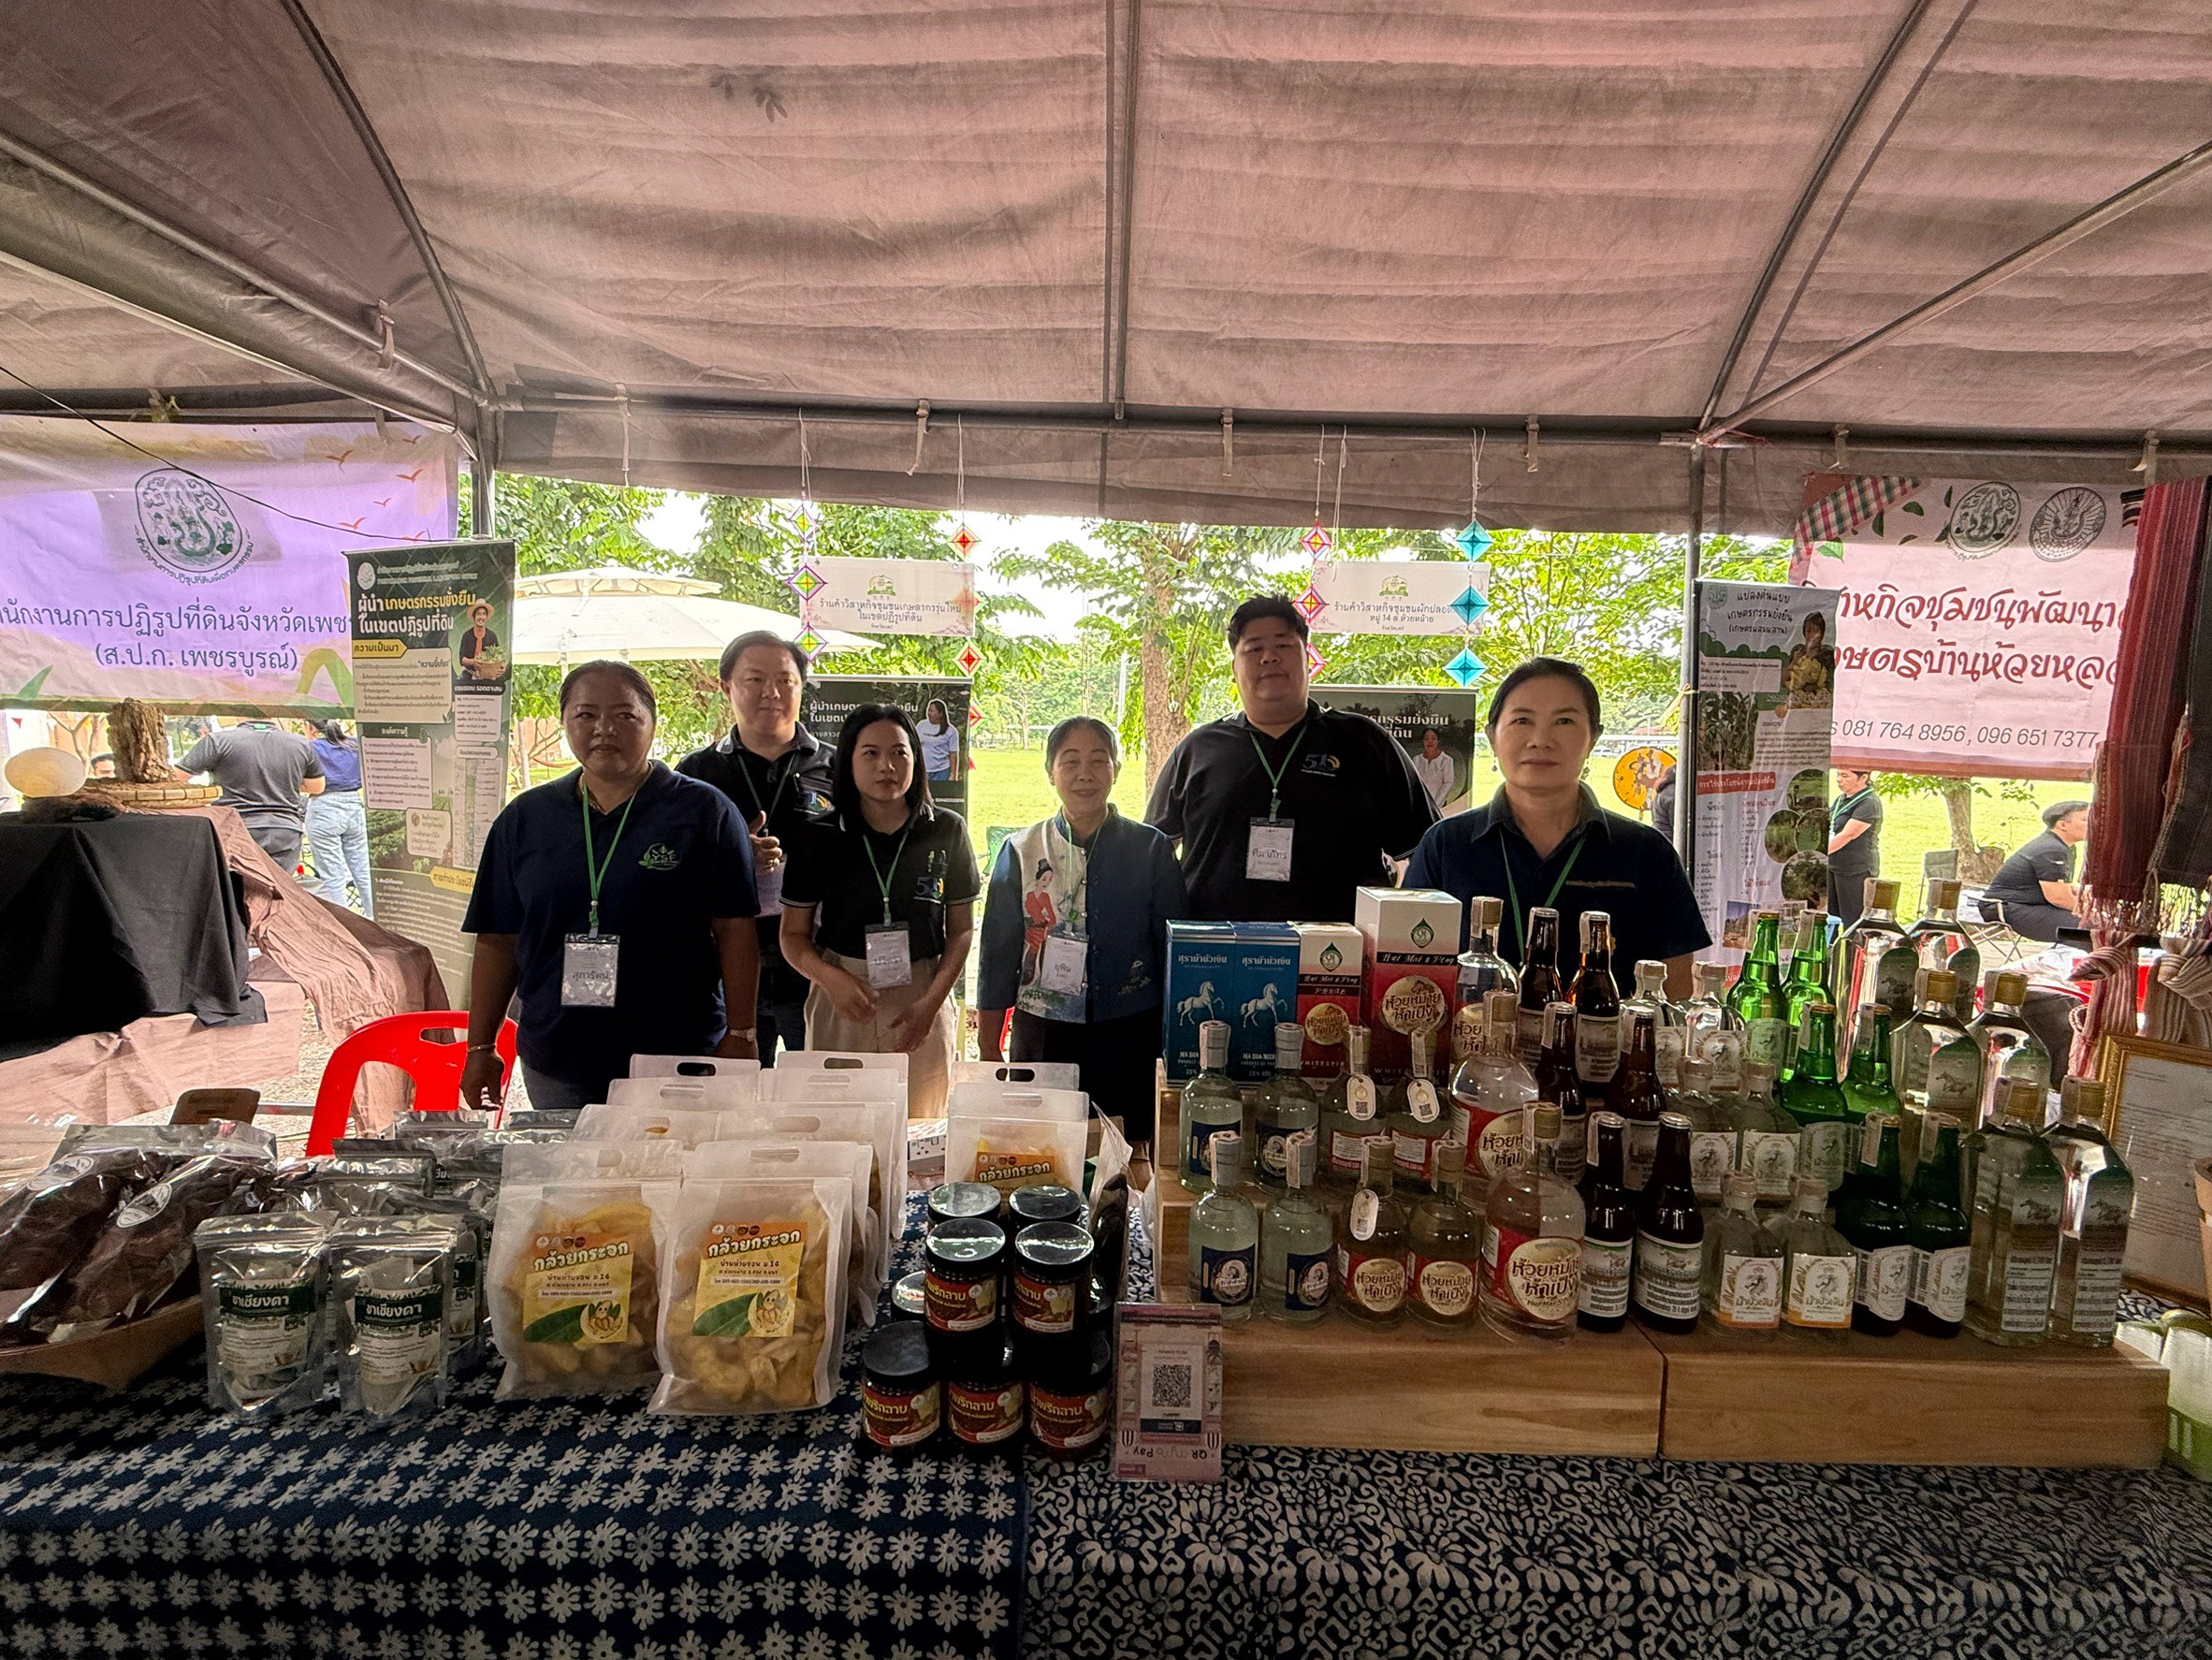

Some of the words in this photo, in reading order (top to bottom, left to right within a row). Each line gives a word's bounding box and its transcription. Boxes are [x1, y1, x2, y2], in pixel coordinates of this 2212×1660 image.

[0, 596, 350, 638] นักงานการปฏิรูปที่ดินจังหวัดเพช
[1334, 601, 1455, 615] ร้านค้าวิสาหกิจชุมชนผักปลอด
[1841, 584, 2127, 633] าหกิจชุมชนพัฒนา
[181, 642, 298, 677] เพชรบูรณ์)
[1835, 639, 2118, 690] ษตรบ้านห้วยหล
[1842, 720, 1873, 737] 081
[1880, 721, 1914, 740] 764
[1977, 726, 2012, 745] 096
[2016, 728, 2046, 746] 651
[2053, 730, 2099, 749] 7377
[1133, 1447, 1154, 1459] Pay
[1191, 1449, 1207, 1460] QR
